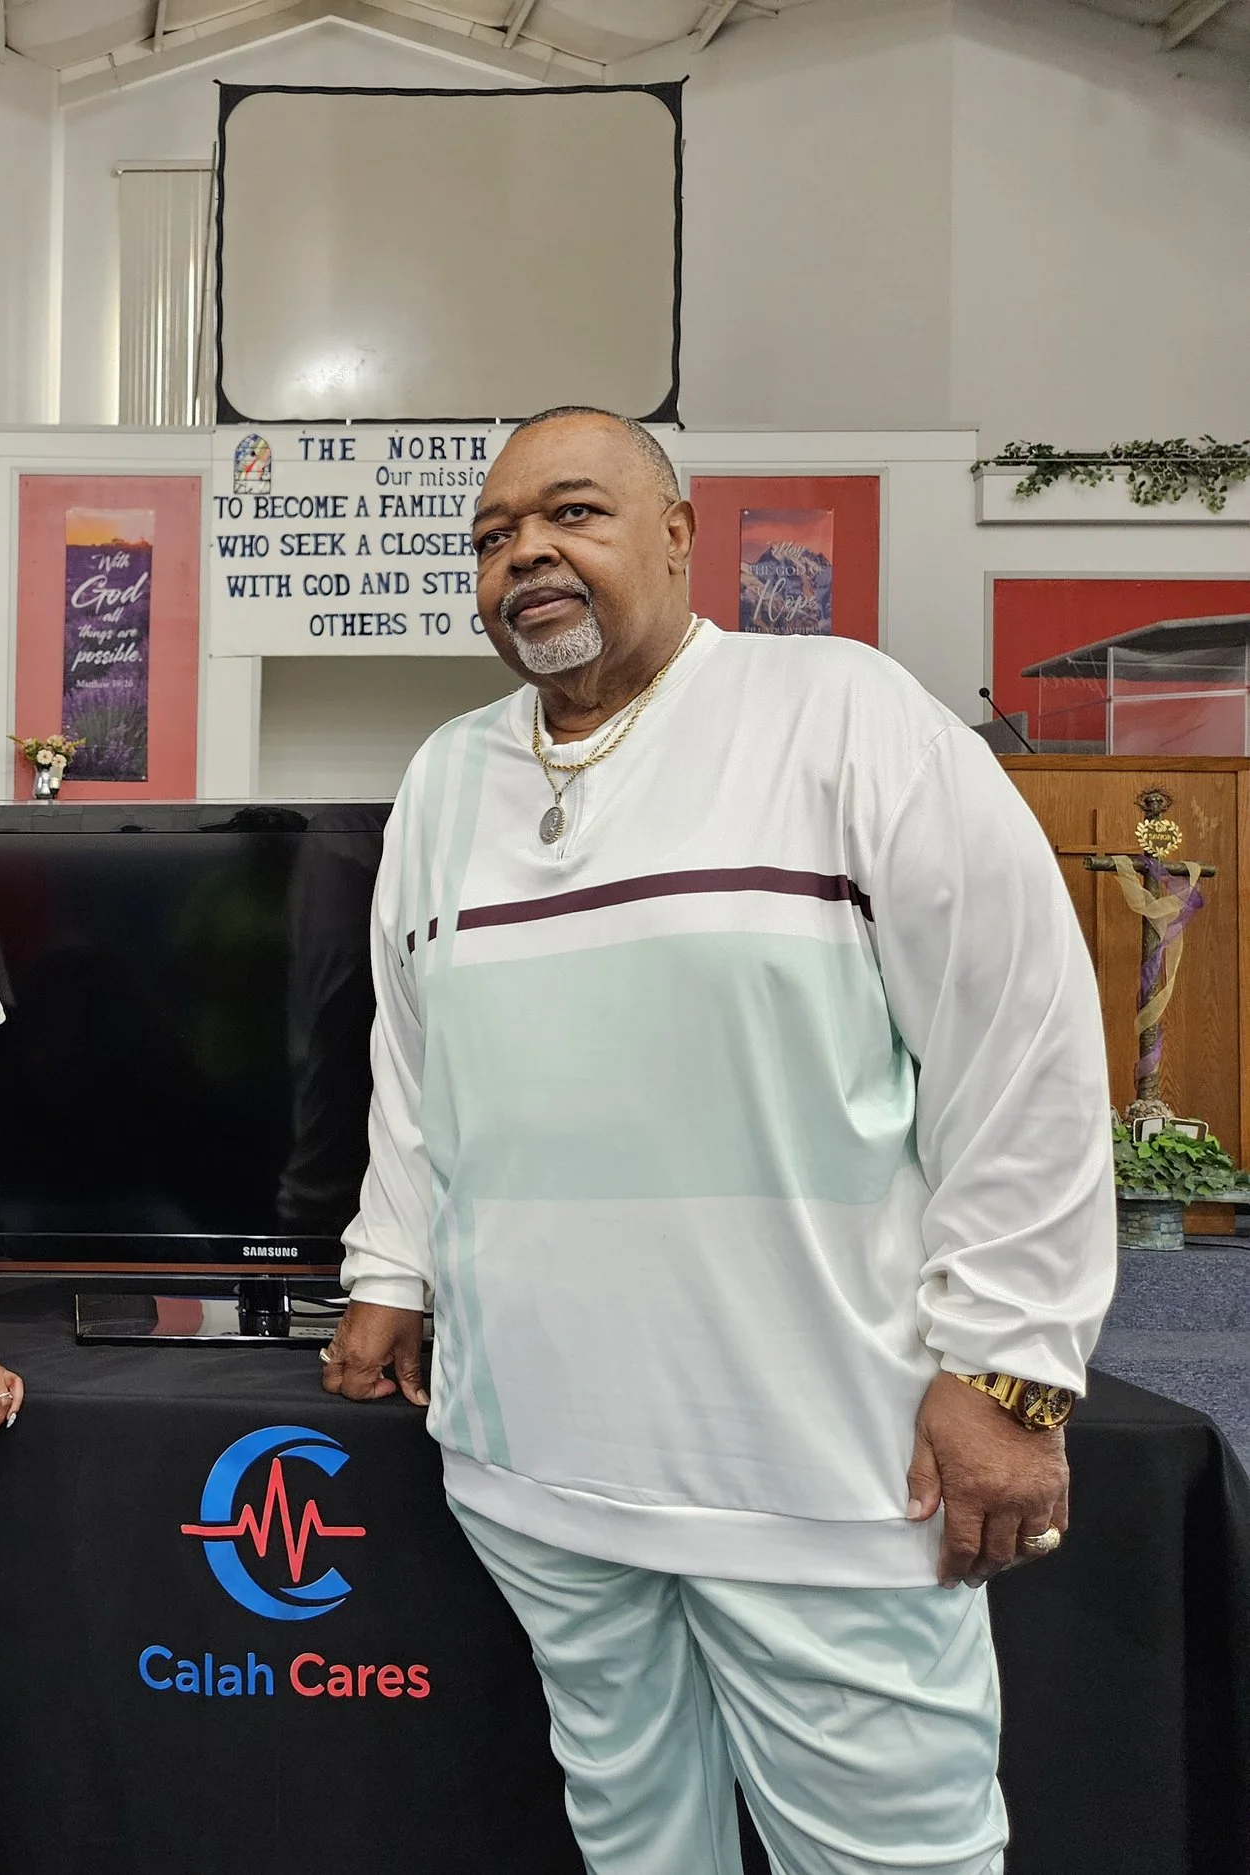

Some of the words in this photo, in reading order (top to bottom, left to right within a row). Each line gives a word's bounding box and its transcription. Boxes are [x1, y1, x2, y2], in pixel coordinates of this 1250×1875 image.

[299, 438, 356, 460] THE
[388, 436, 487, 460] NORTH
[376, 466, 412, 486] Our
[420, 467, 485, 486] missio
[214, 496, 243, 519] TO
[253, 496, 347, 519] BECOME
[354, 496, 371, 518] A
[379, 494, 466, 518] FAMILY
[217, 534, 269, 558] WHO
[280, 533, 346, 556] SEEK
[355, 534, 372, 556] A
[380, 532, 475, 556] CLOSER
[91, 551, 130, 572] With
[776, 566, 806, 577] GOD
[71, 571, 149, 614] God
[227, 575, 292, 597] WITH
[303, 574, 350, 596] GOD
[360, 572, 409, 595] AND
[422, 572, 478, 594] STR
[753, 578, 818, 622] Hope
[102, 607, 125, 623] all
[310, 613, 407, 636] OTHERS
[420, 613, 450, 635] TO
[77, 624, 113, 645] things
[117, 628, 138, 639] are
[70, 642, 143, 672] possible.
[242, 1246, 299, 1257] SAMSUNG
[139, 1644, 274, 1697] Calah
[290, 1652, 431, 1698] Cares
